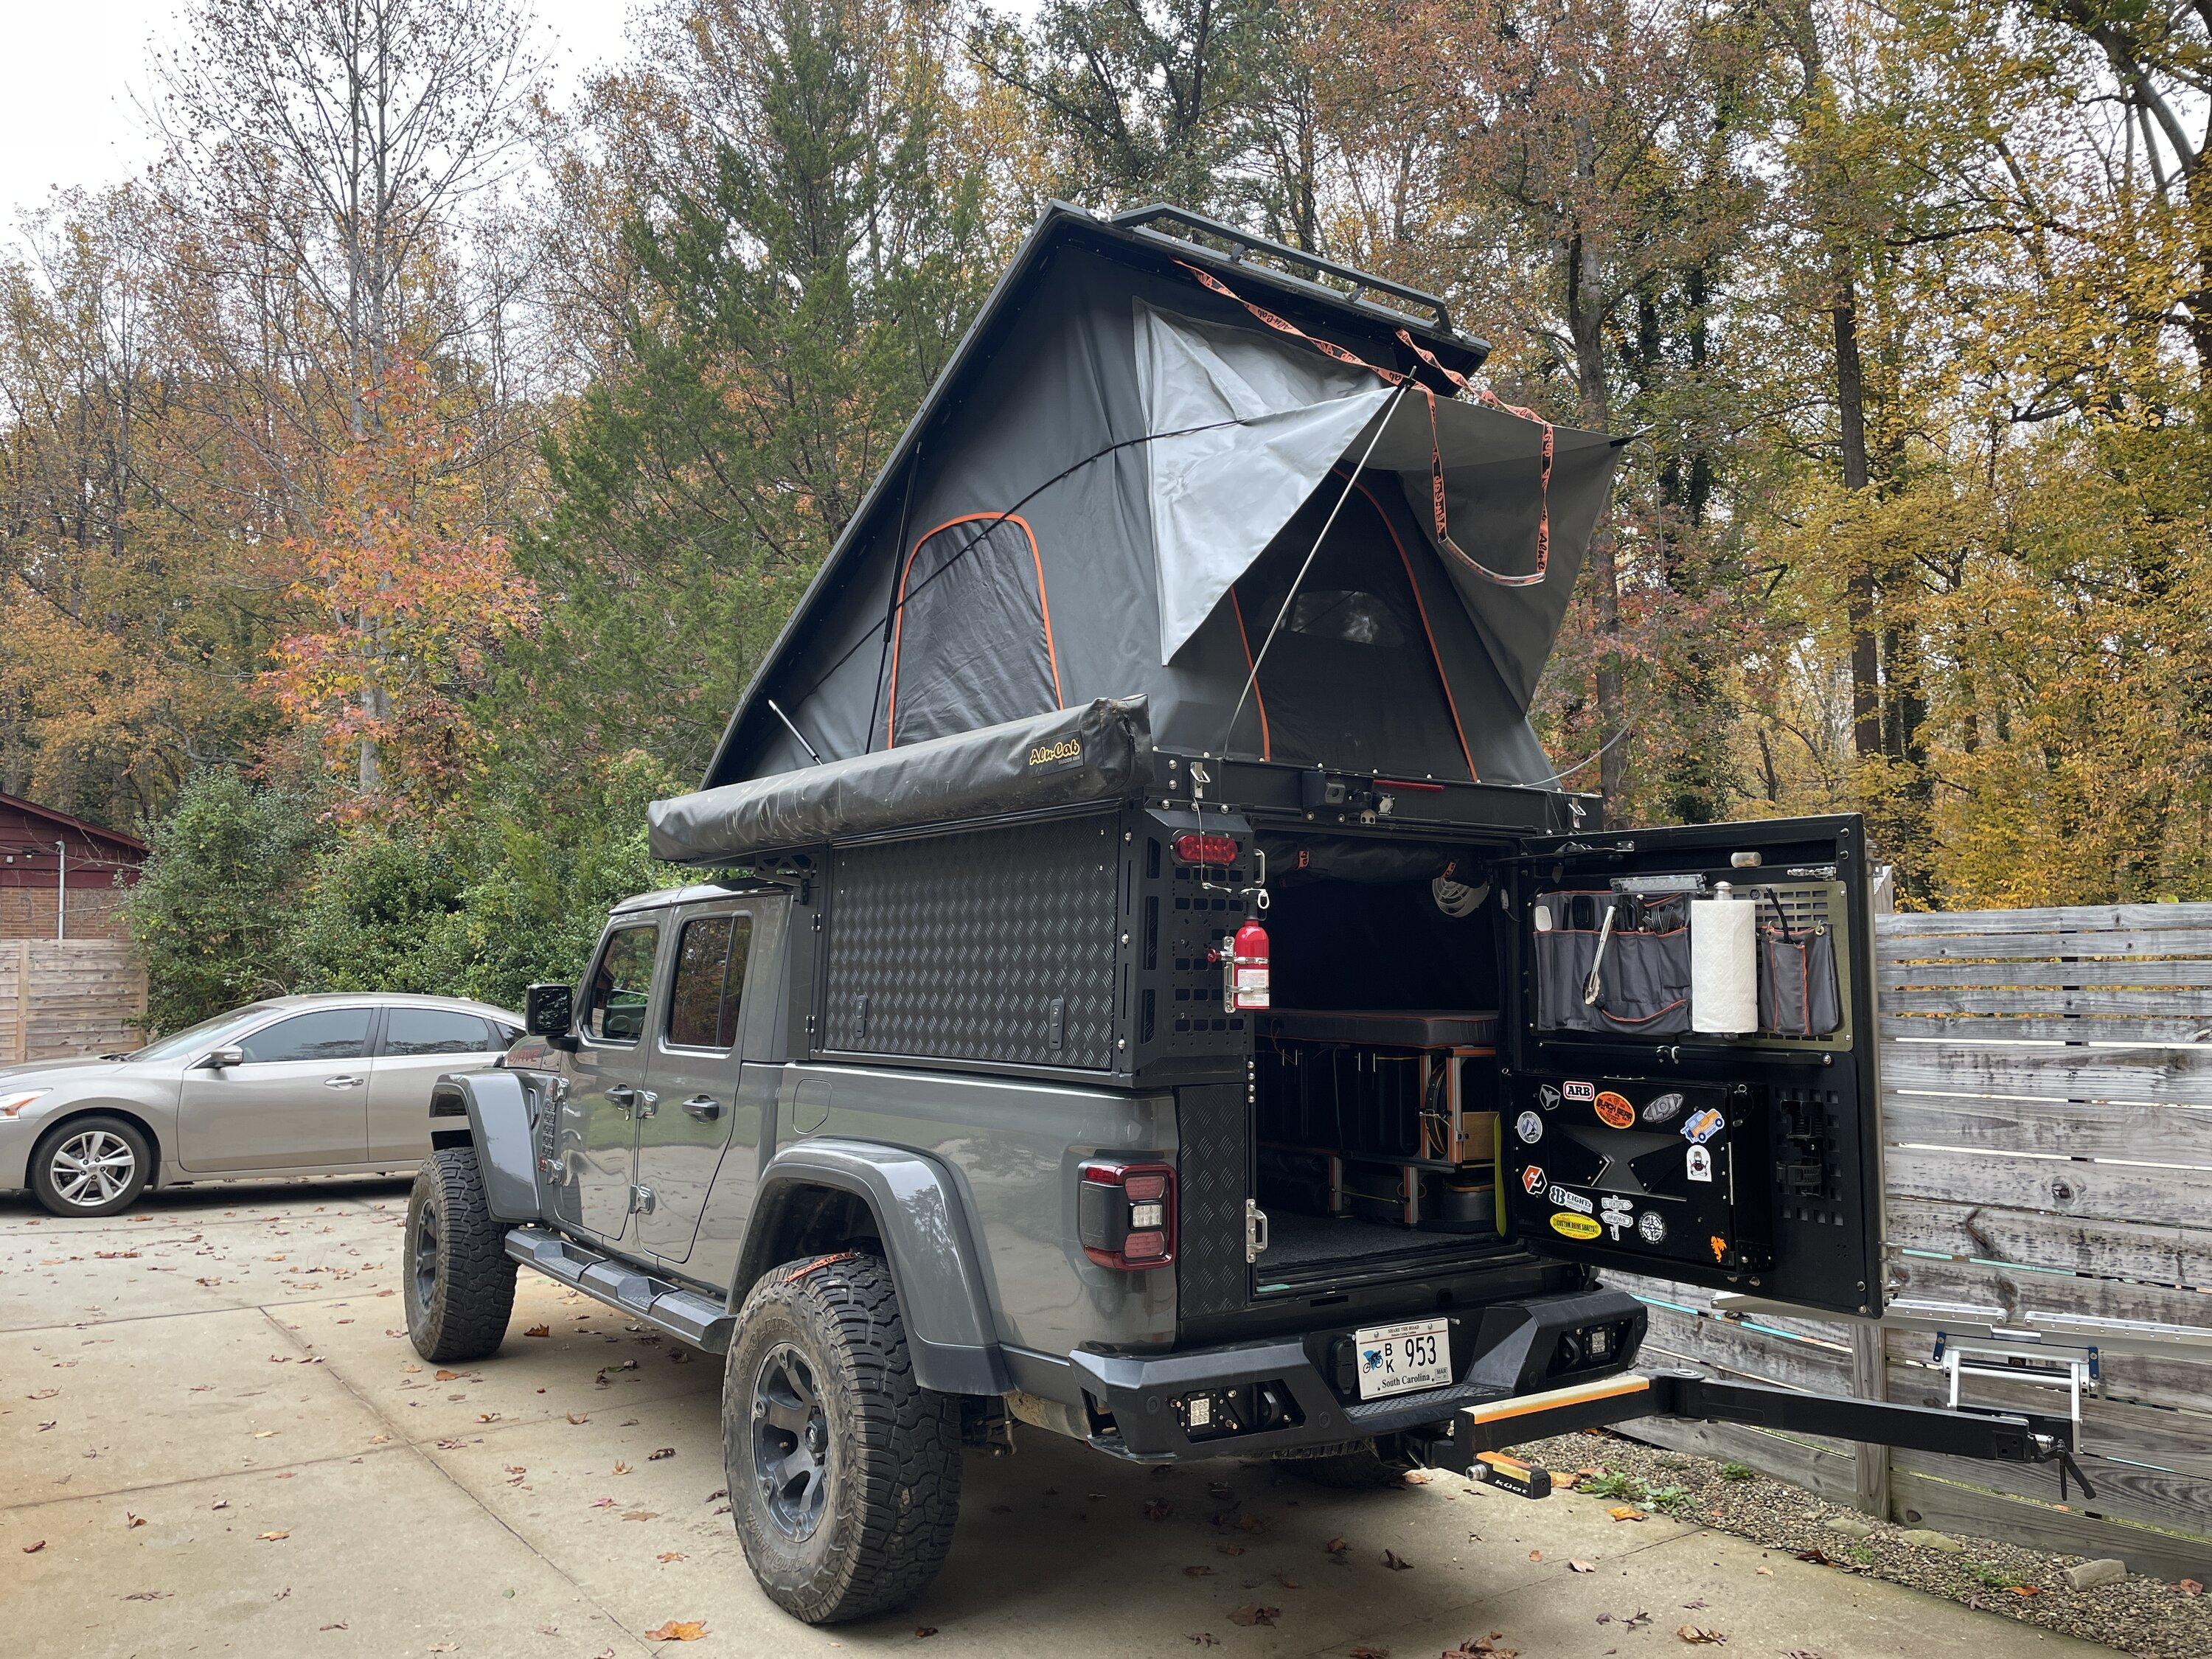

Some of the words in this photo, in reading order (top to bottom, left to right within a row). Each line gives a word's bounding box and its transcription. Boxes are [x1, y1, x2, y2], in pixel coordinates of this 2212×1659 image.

[1029, 739, 1080, 766] Alu-Cab
[1567, 1085, 1590, 1096] ARB
[1385, 1343, 1393, 1357] B
[1405, 1335, 1436, 1368] 953
[1386, 1358, 1395, 1374] K
[1382, 1377, 1401, 1388] South
[1402, 1373, 1430, 1384] Carolina
